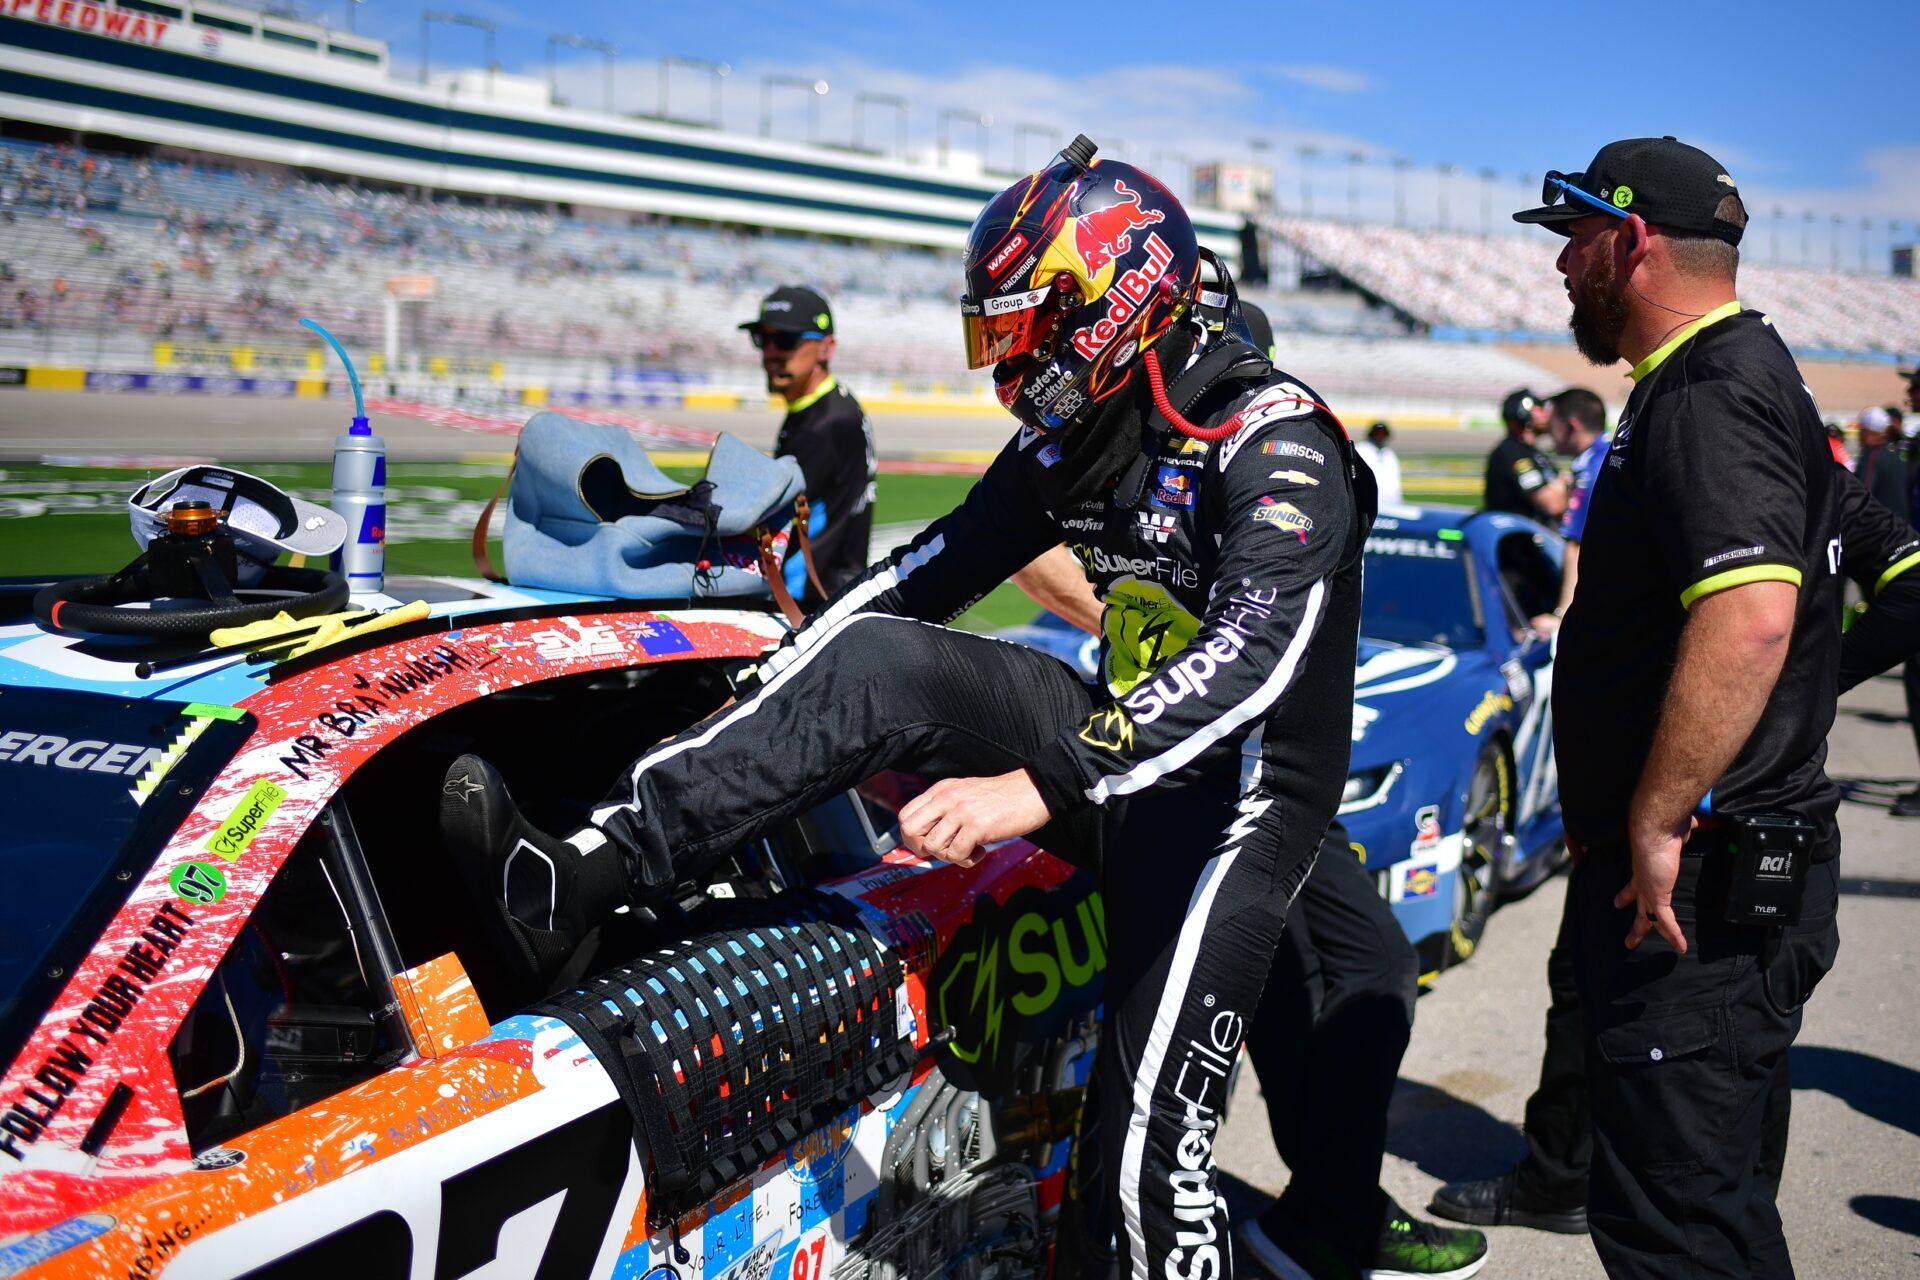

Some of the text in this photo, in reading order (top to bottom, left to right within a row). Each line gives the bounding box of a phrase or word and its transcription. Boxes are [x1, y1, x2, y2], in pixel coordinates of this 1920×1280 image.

[0, 0, 169, 47] PEEDWAY
[987, 235, 1023, 272] WARD
[999, 254, 1038, 294] TRACKHOUSE
[991, 298, 1024, 310] Group
[1072, 231, 1175, 362] Red Bull
[1023, 362, 1062, 399] Safety
[1033, 370, 1074, 408] Culture
[1060, 393, 1088, 419] LOCK
[1157, 455, 1204, 470] HEVROLE
[1279, 441, 1326, 466] NASCAR
[1256, 507, 1313, 530] SUNOCO
[1124, 587, 1278, 725] SuperFile
[0, 730, 163, 776] ERGEN
[279, 734, 333, 781] MR
[227, 783, 281, 844] SuperFile
[177, 864, 222, 904] 97
[1759, 856, 1785, 872] RCI
[1754, 905, 1777, 914] TYLER
[0, 1037, 94, 1162] FOLLOW
[69, 973, 145, 1046] YOUR
[118, 901, 196, 986] HEART
[688, 1236, 726, 1280] YOUR
[793, 1234, 827, 1280] 97
